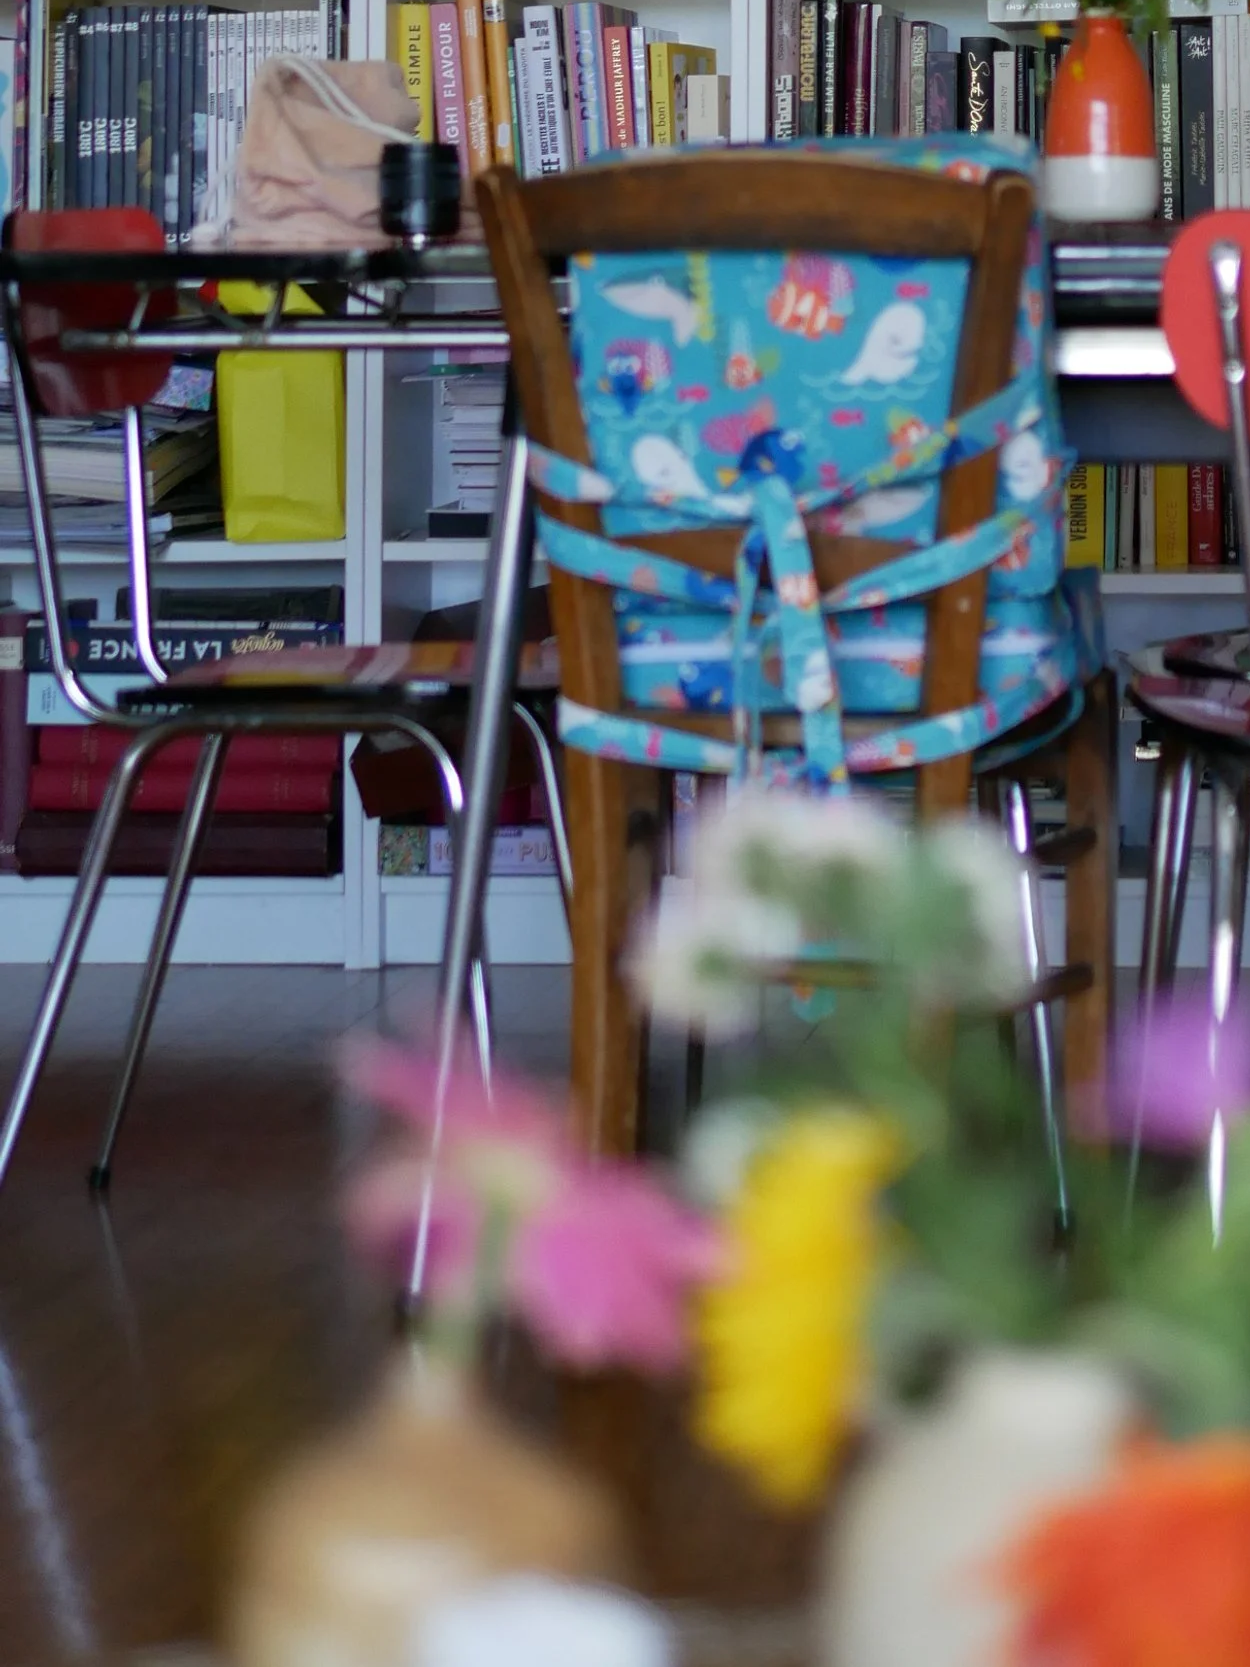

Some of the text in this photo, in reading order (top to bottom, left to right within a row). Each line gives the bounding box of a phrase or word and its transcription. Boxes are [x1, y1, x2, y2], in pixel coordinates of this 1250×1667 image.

[408, 24, 422, 86] SIMPLE
[437, 21, 454, 100] FLAVOUR
[825, 31, 834, 114] FILM PAR FILM
[1161, 83, 1174, 222] ANS DE MODE MASCULINE
